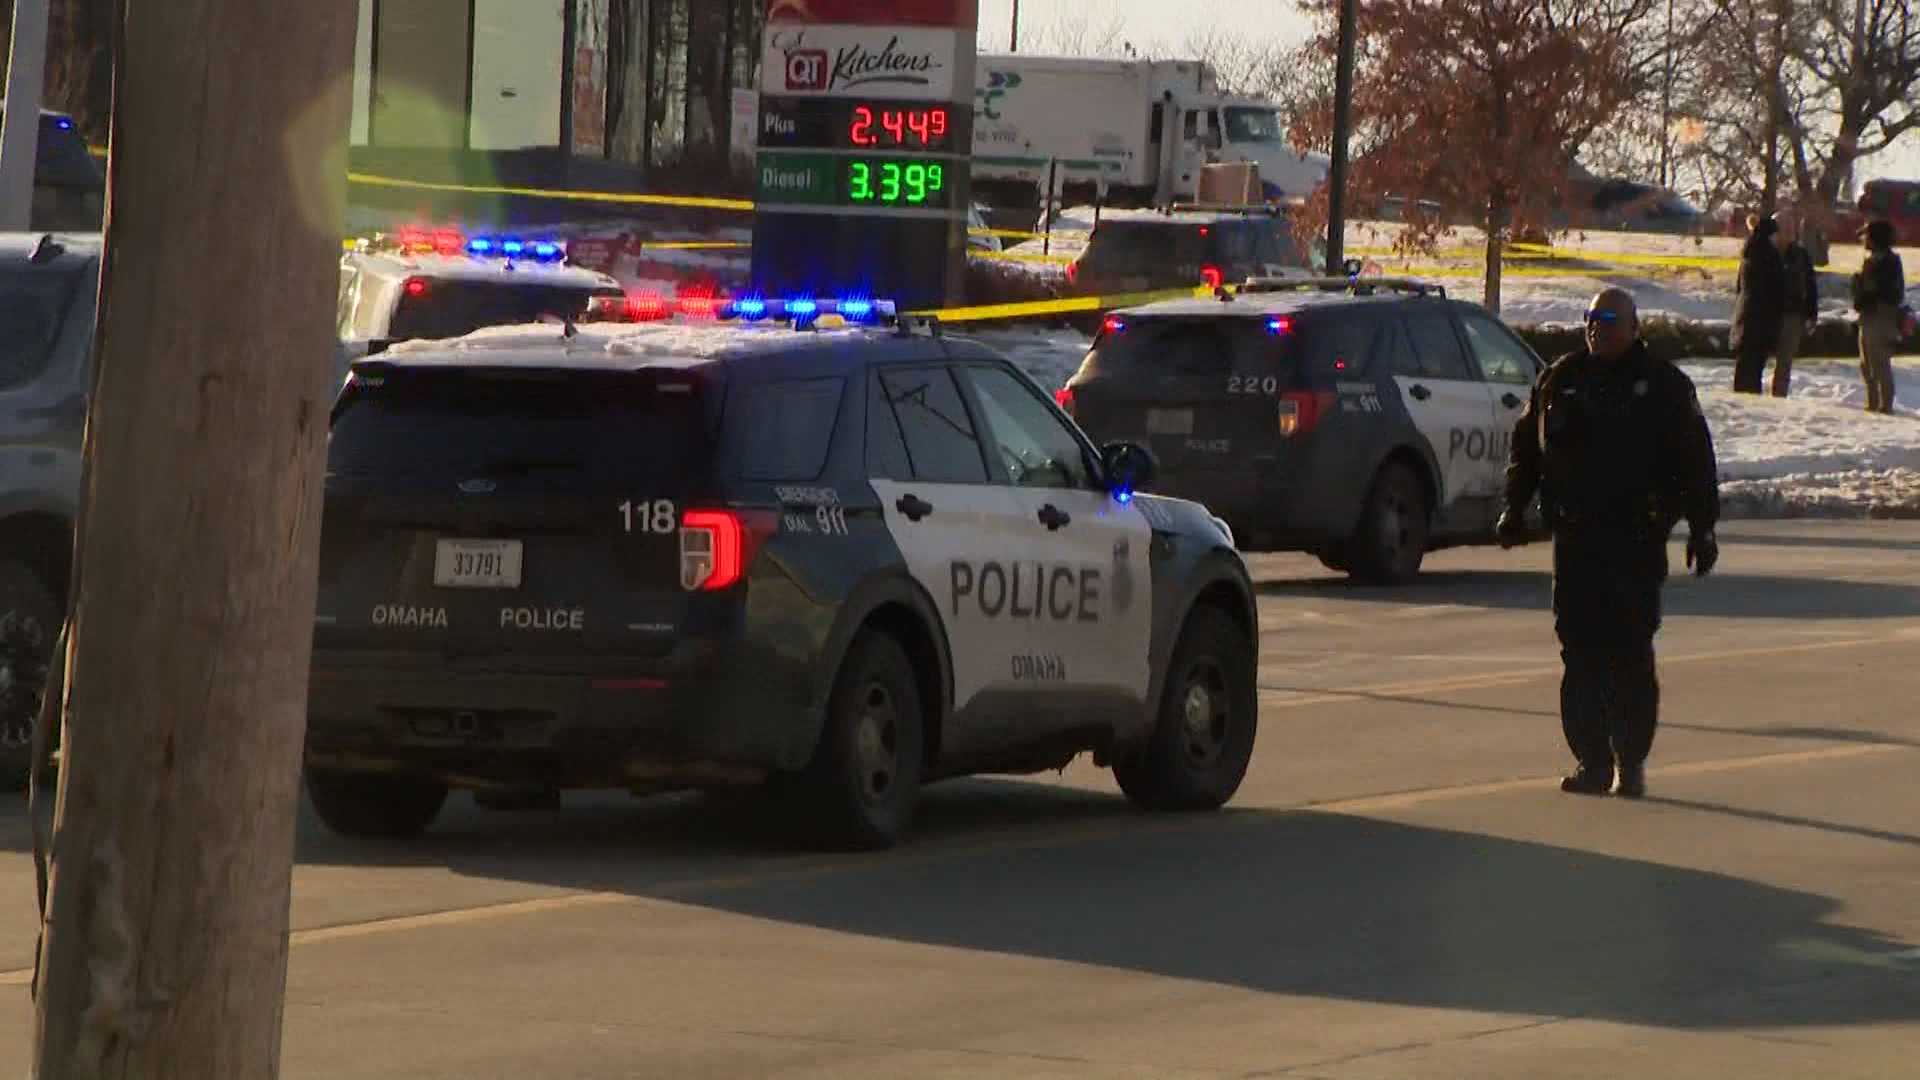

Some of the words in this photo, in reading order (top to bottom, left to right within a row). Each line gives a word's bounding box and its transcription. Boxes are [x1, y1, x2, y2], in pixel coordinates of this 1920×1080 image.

[787, 54, 823, 84] QT
[828, 35, 932, 90] Kitchens
[764, 113, 796, 133] Plus
[762, 168, 812, 188] Diesel
[1227, 376, 1277, 393] 220
[618, 500, 675, 533] 118
[815, 505, 849, 536] 911
[453, 551, 504, 576] 33791
[951, 561, 1100, 622] POLICE
[371, 604, 448, 628] OMAHA
[500, 607, 584, 630] POLICE
[1011, 655, 1065, 681] OMAHA
